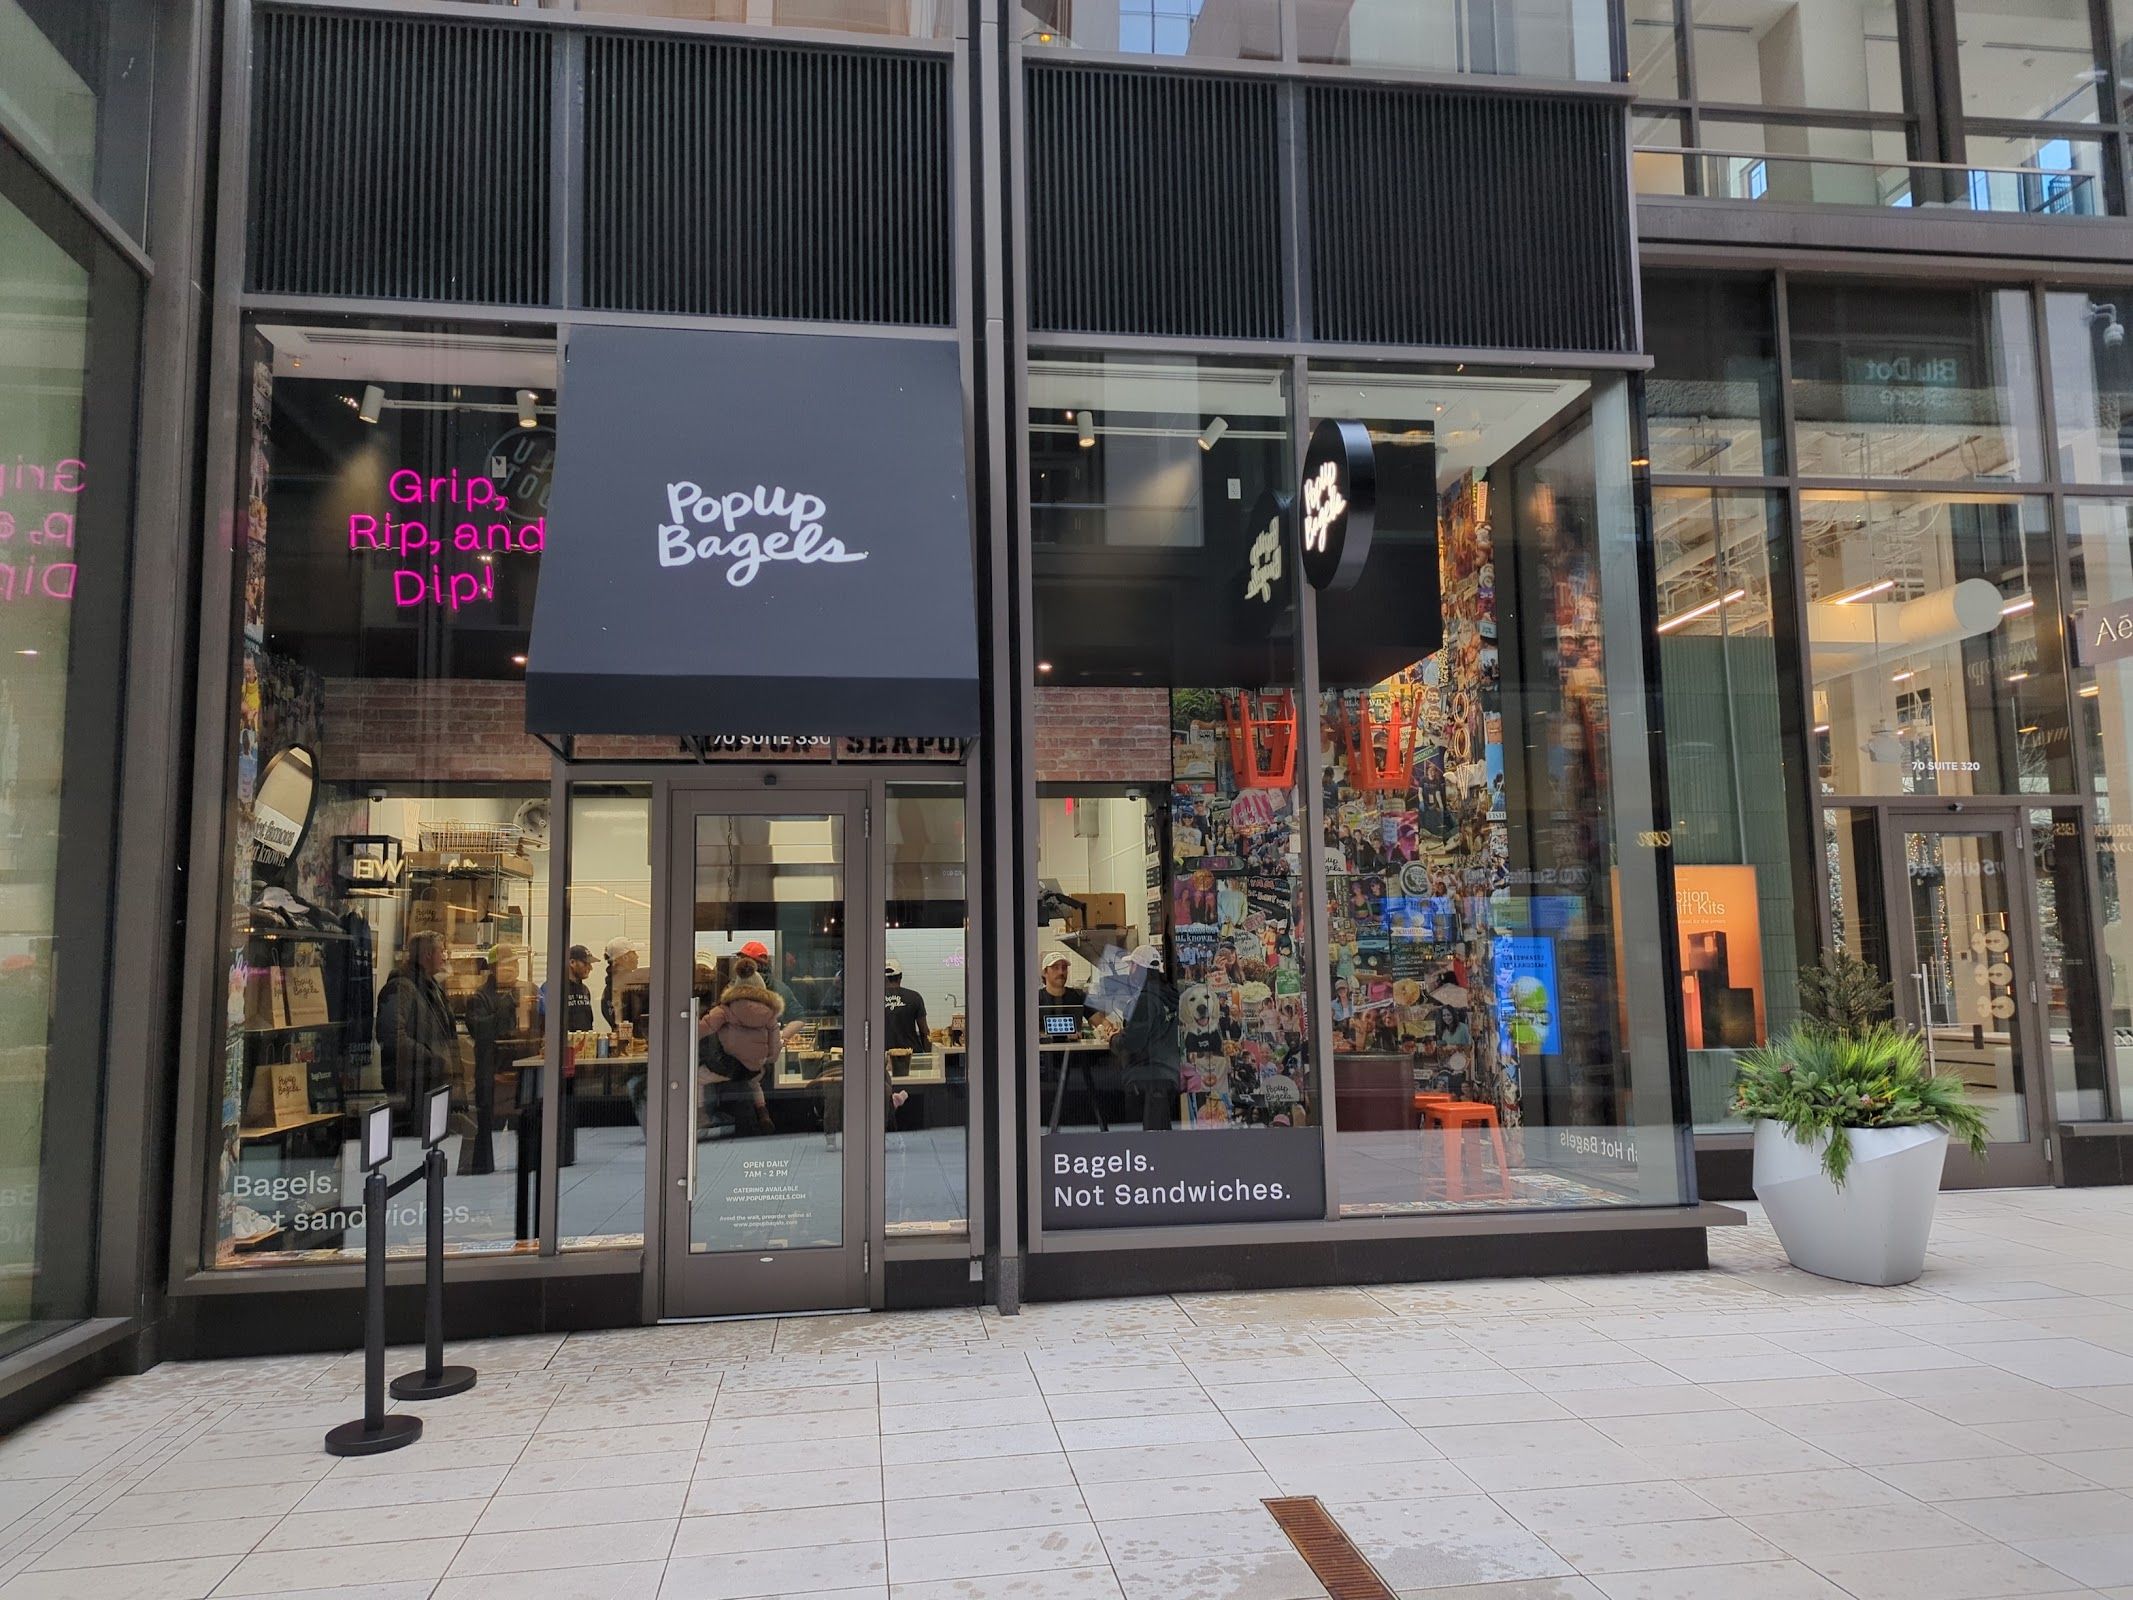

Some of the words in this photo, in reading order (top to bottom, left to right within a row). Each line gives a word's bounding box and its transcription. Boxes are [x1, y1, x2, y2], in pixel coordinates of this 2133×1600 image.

[389, 468, 509, 512] Grip,
[350, 512, 441, 557] Rip,
[455, 517, 545, 554] and
[658, 522, 869, 588] Bagels
[395, 564, 493, 611] Dip!
[1911, 761, 1926, 771] 70
[1928, 761, 1958, 771] SUITE
[1960, 761, 1981, 771] 320
[1697, 900, 1726, 915] Kits
[743, 1161, 765, 1169] OPEN
[766, 1160, 790, 1168] DAILY
[776, 1169, 788, 1177] PM
[1054, 1149, 1155, 1178] Bagels.
[233, 1170, 338, 1201] Bagels.
[1054, 1185, 1104, 1207] Not
[1115, 1179, 1291, 1205] Sandwiches.
